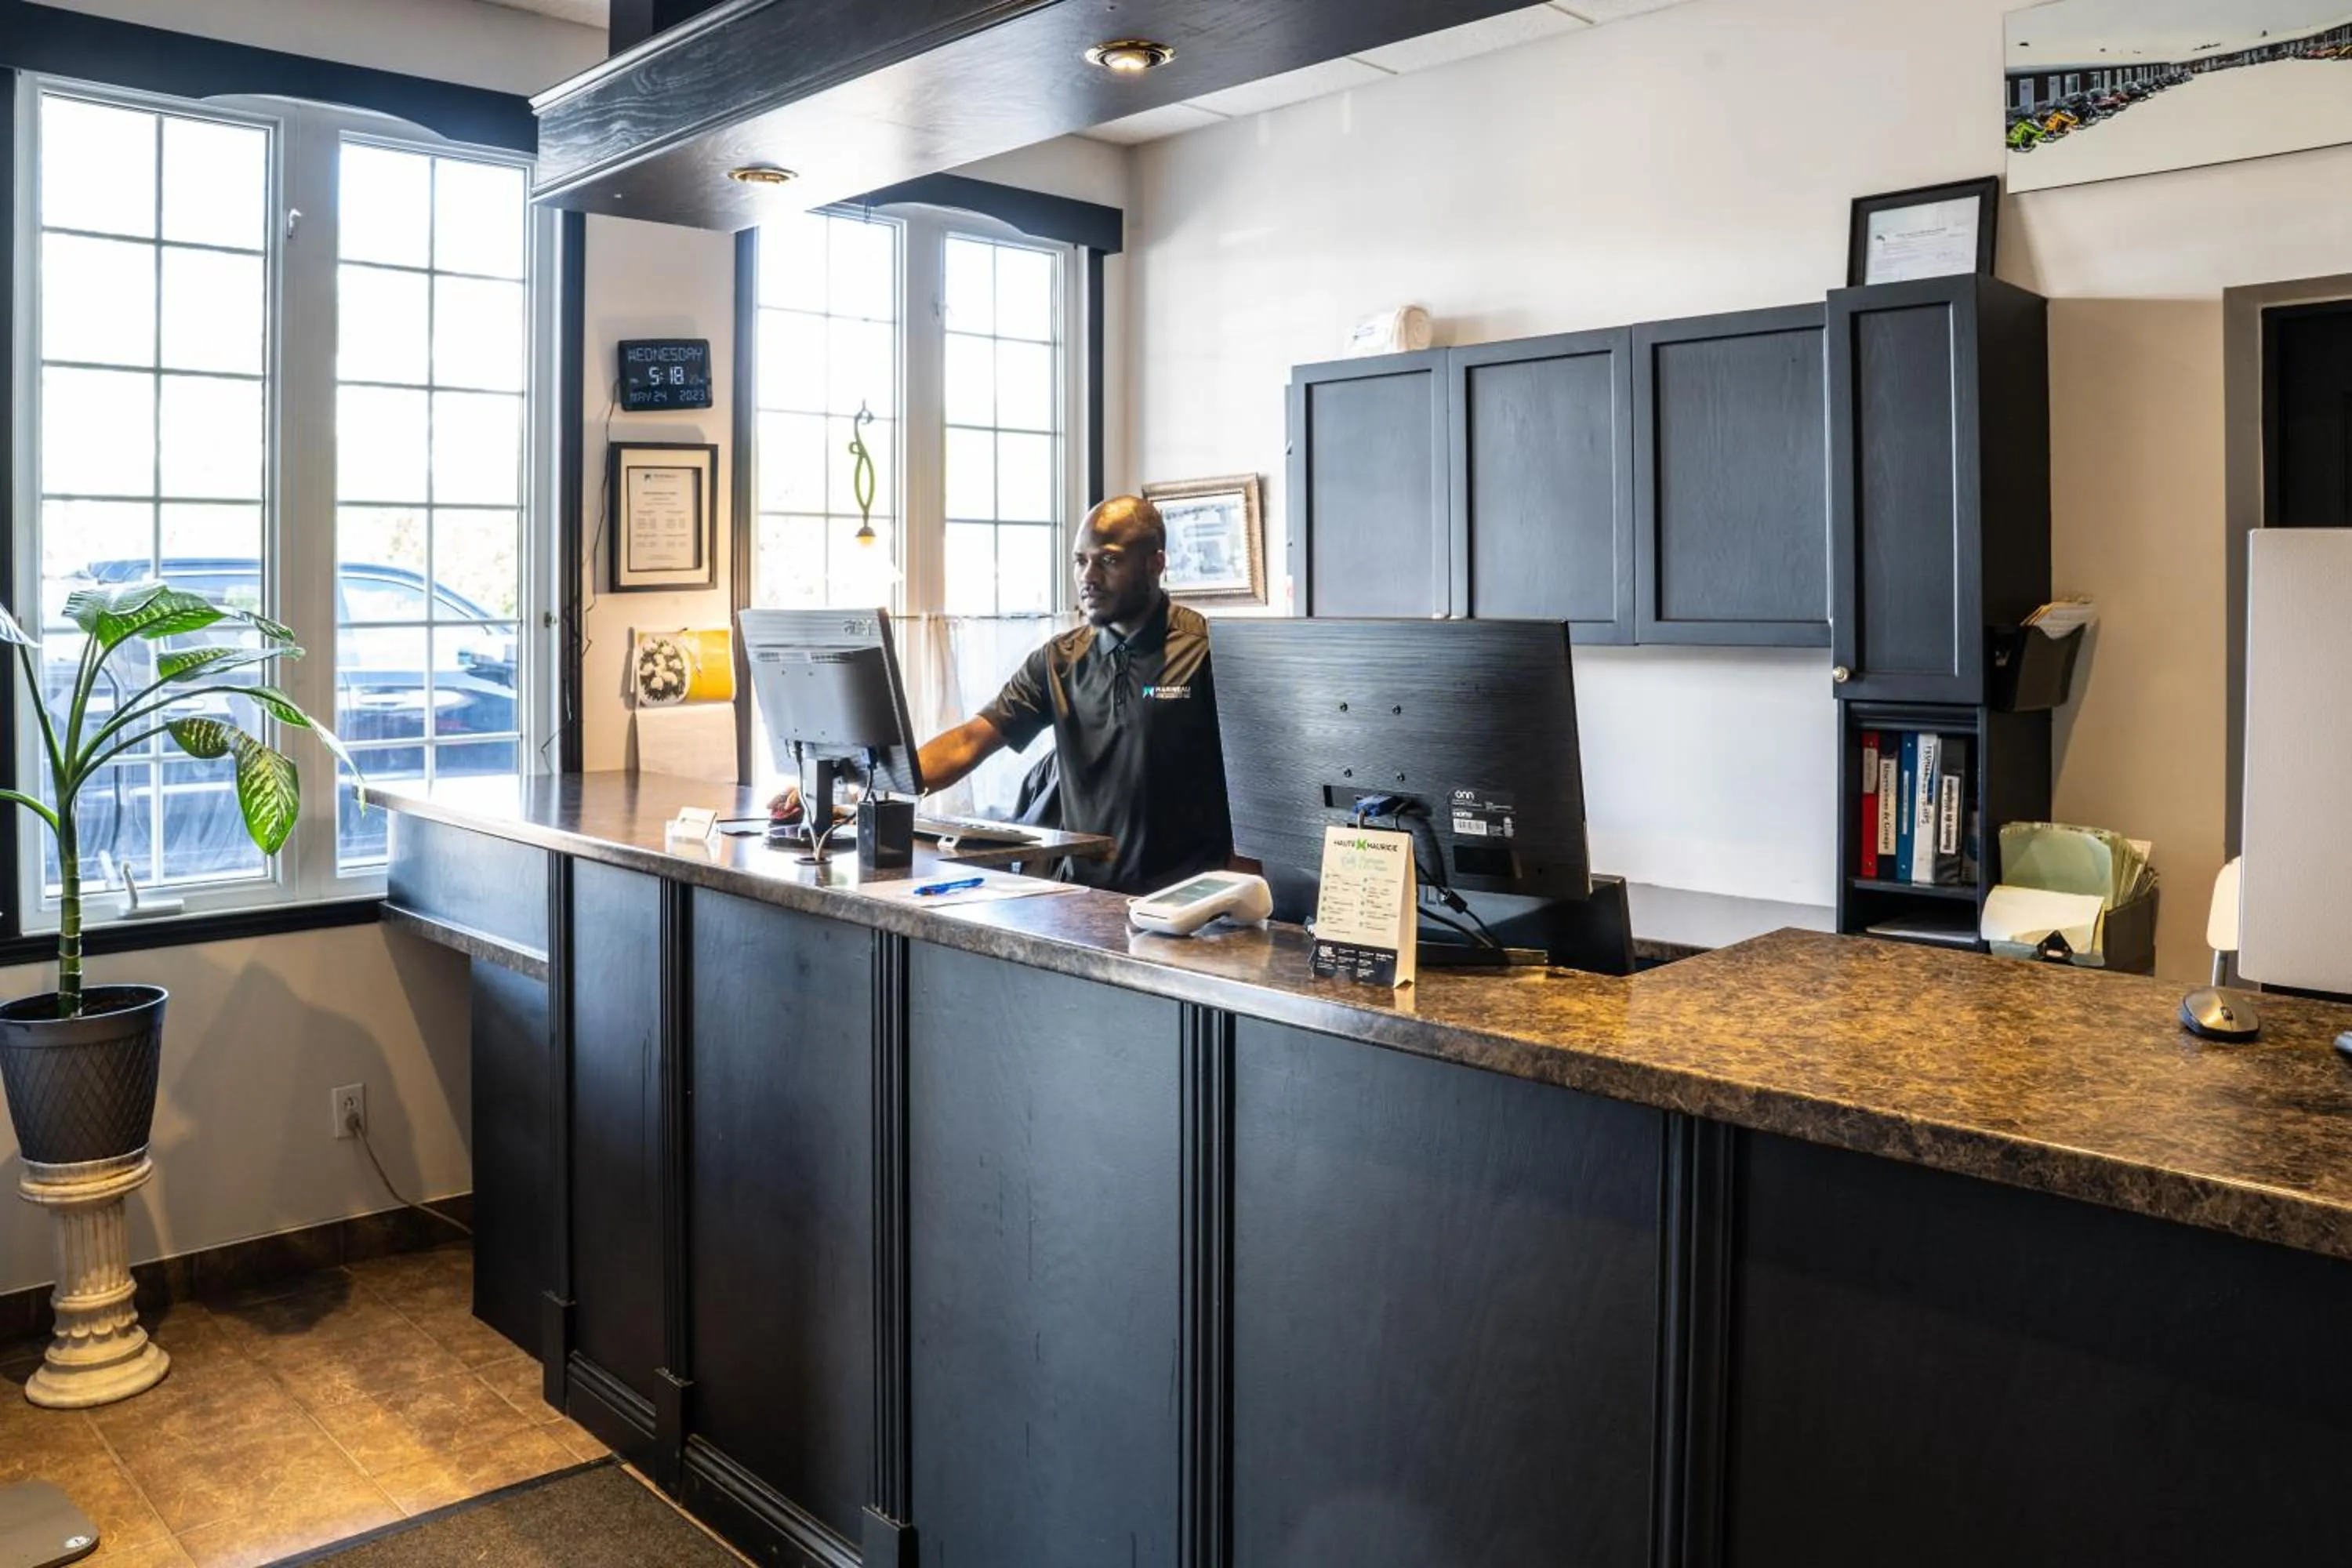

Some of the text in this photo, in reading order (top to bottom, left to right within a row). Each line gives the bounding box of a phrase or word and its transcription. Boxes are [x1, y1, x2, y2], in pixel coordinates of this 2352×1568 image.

[628, 347, 703, 362] WEDNESDAY
[648, 365, 684, 385] 5:18
[630, 389, 705, 403] MAY 24 2023
